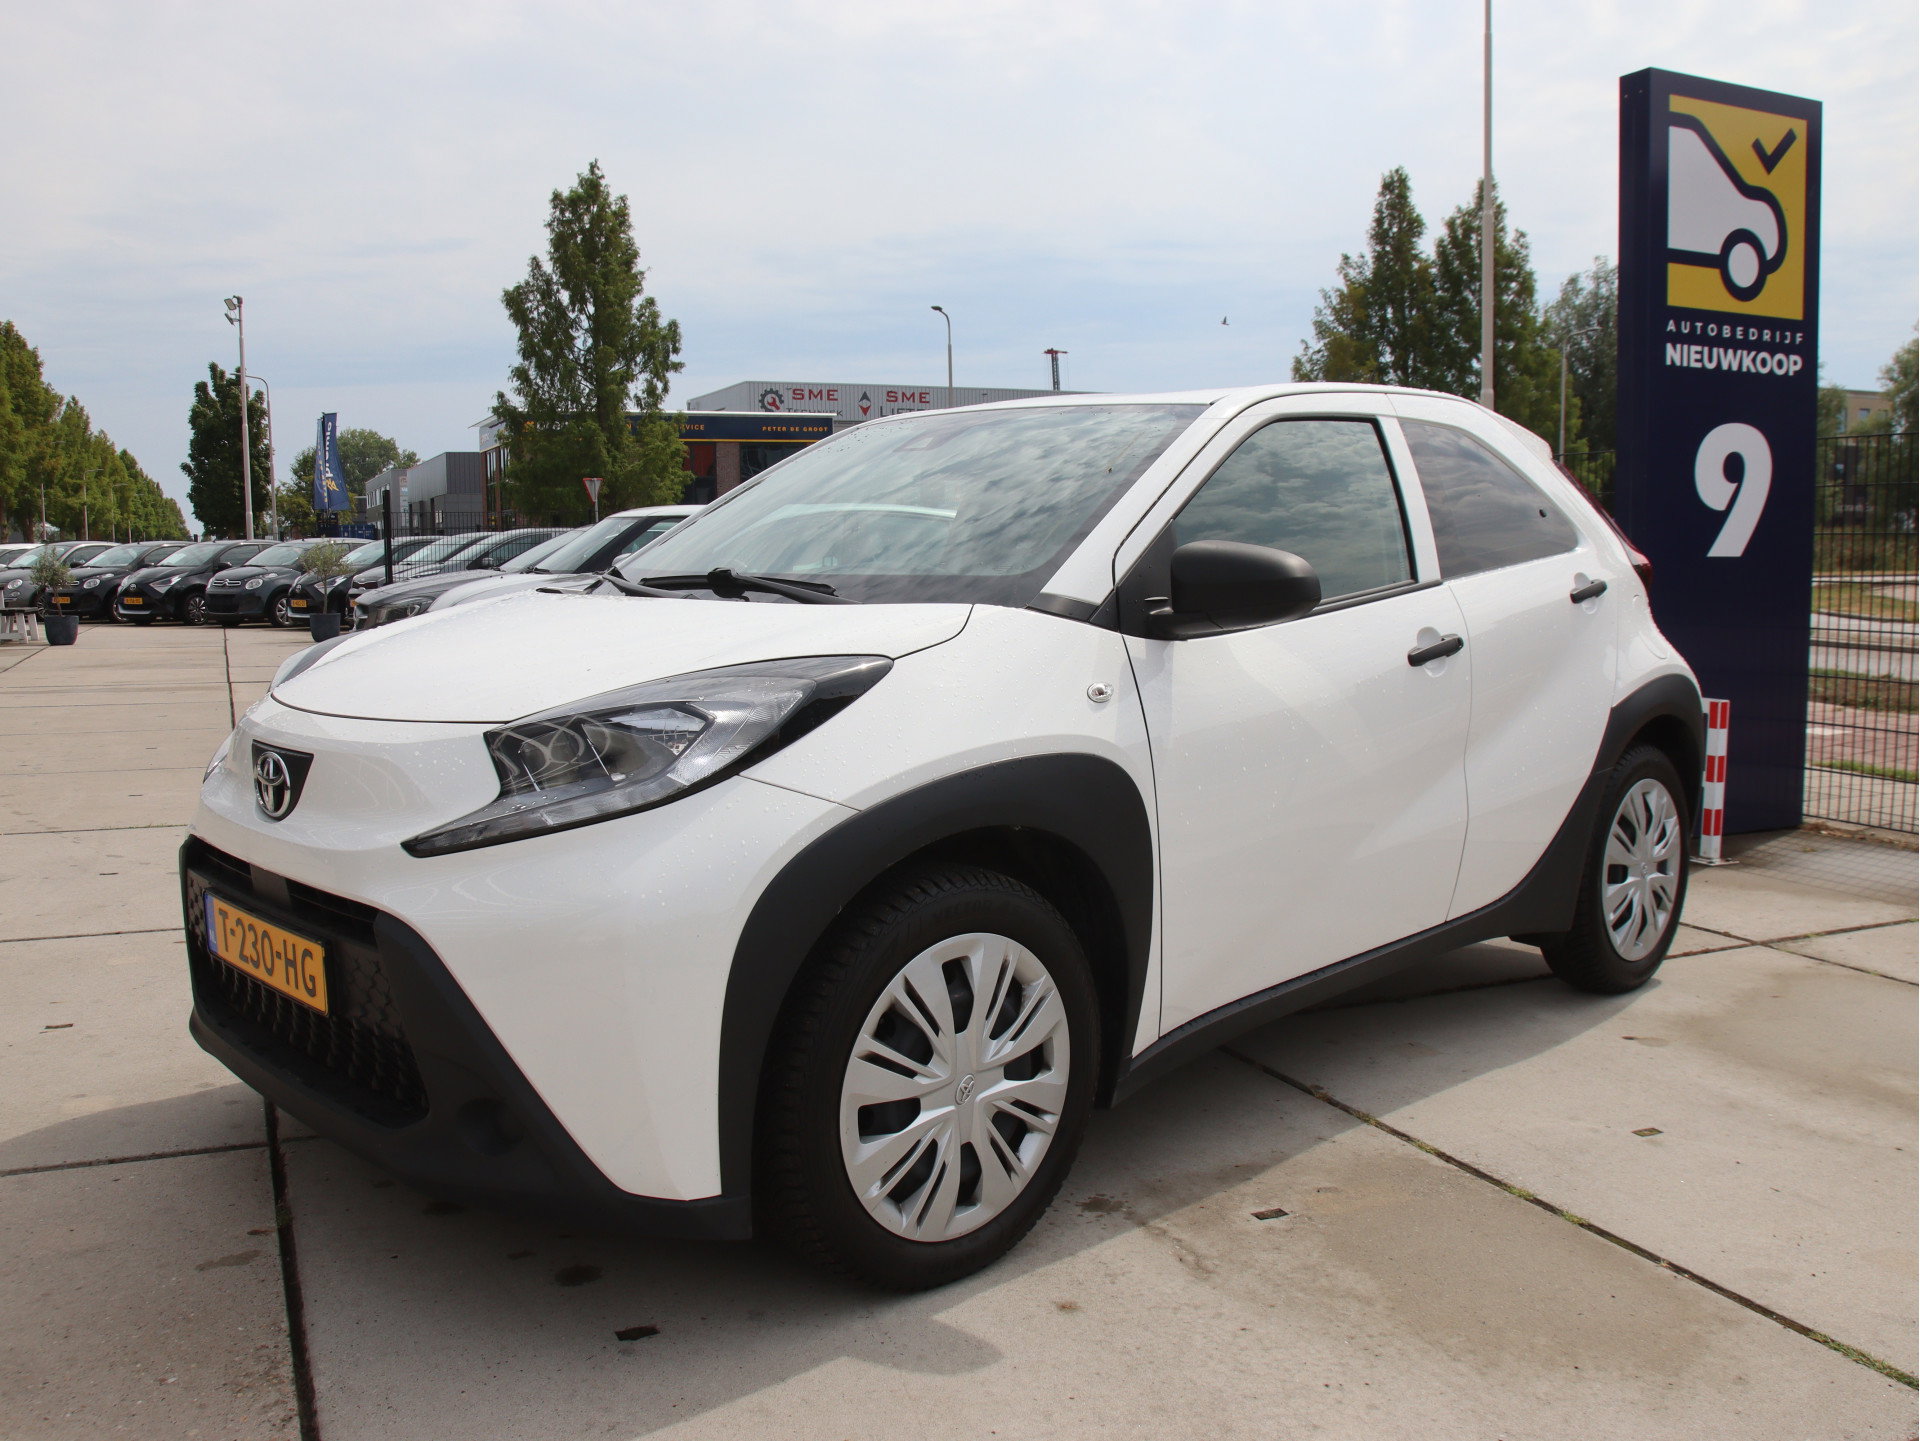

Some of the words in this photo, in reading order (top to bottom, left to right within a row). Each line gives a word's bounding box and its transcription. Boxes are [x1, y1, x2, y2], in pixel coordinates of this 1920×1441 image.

[1666, 319, 1803, 345] AUTOBEDRIJF
[1665, 342, 1803, 376] NIEUWKOOP
[792, 388, 839, 402] SME
[886, 390, 931, 403] SME
[1694, 422, 1773, 558] 9
[218, 907, 317, 998] T-230-HG
